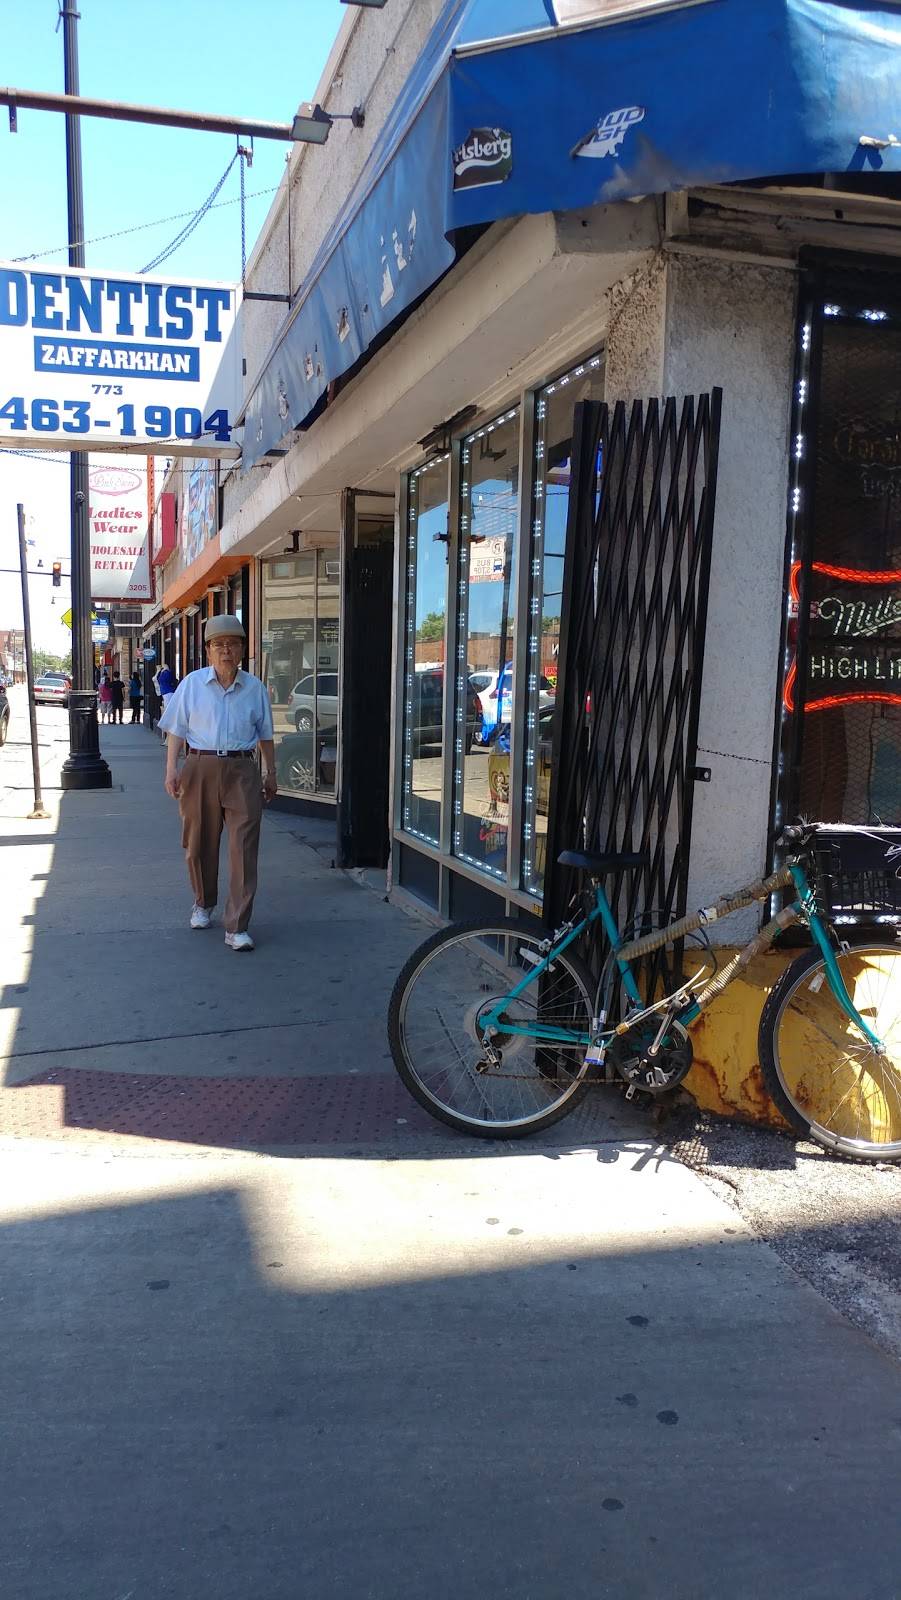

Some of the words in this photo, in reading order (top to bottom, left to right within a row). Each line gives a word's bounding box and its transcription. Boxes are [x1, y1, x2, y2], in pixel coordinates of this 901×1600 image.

[0, 268, 231, 342] DENTIST
[41, 344, 191, 373] ZAFFARKHAN
[91, 383, 123, 396] 773
[0, 396, 232, 442] 463-1904
[88, 507, 143, 519] Ladies
[93, 522, 138, 533] Wear
[94, 560, 135, 571] RETAIL
[129, 584, 147, 592] 3205
[811, 656, 867, 679] HIGH
